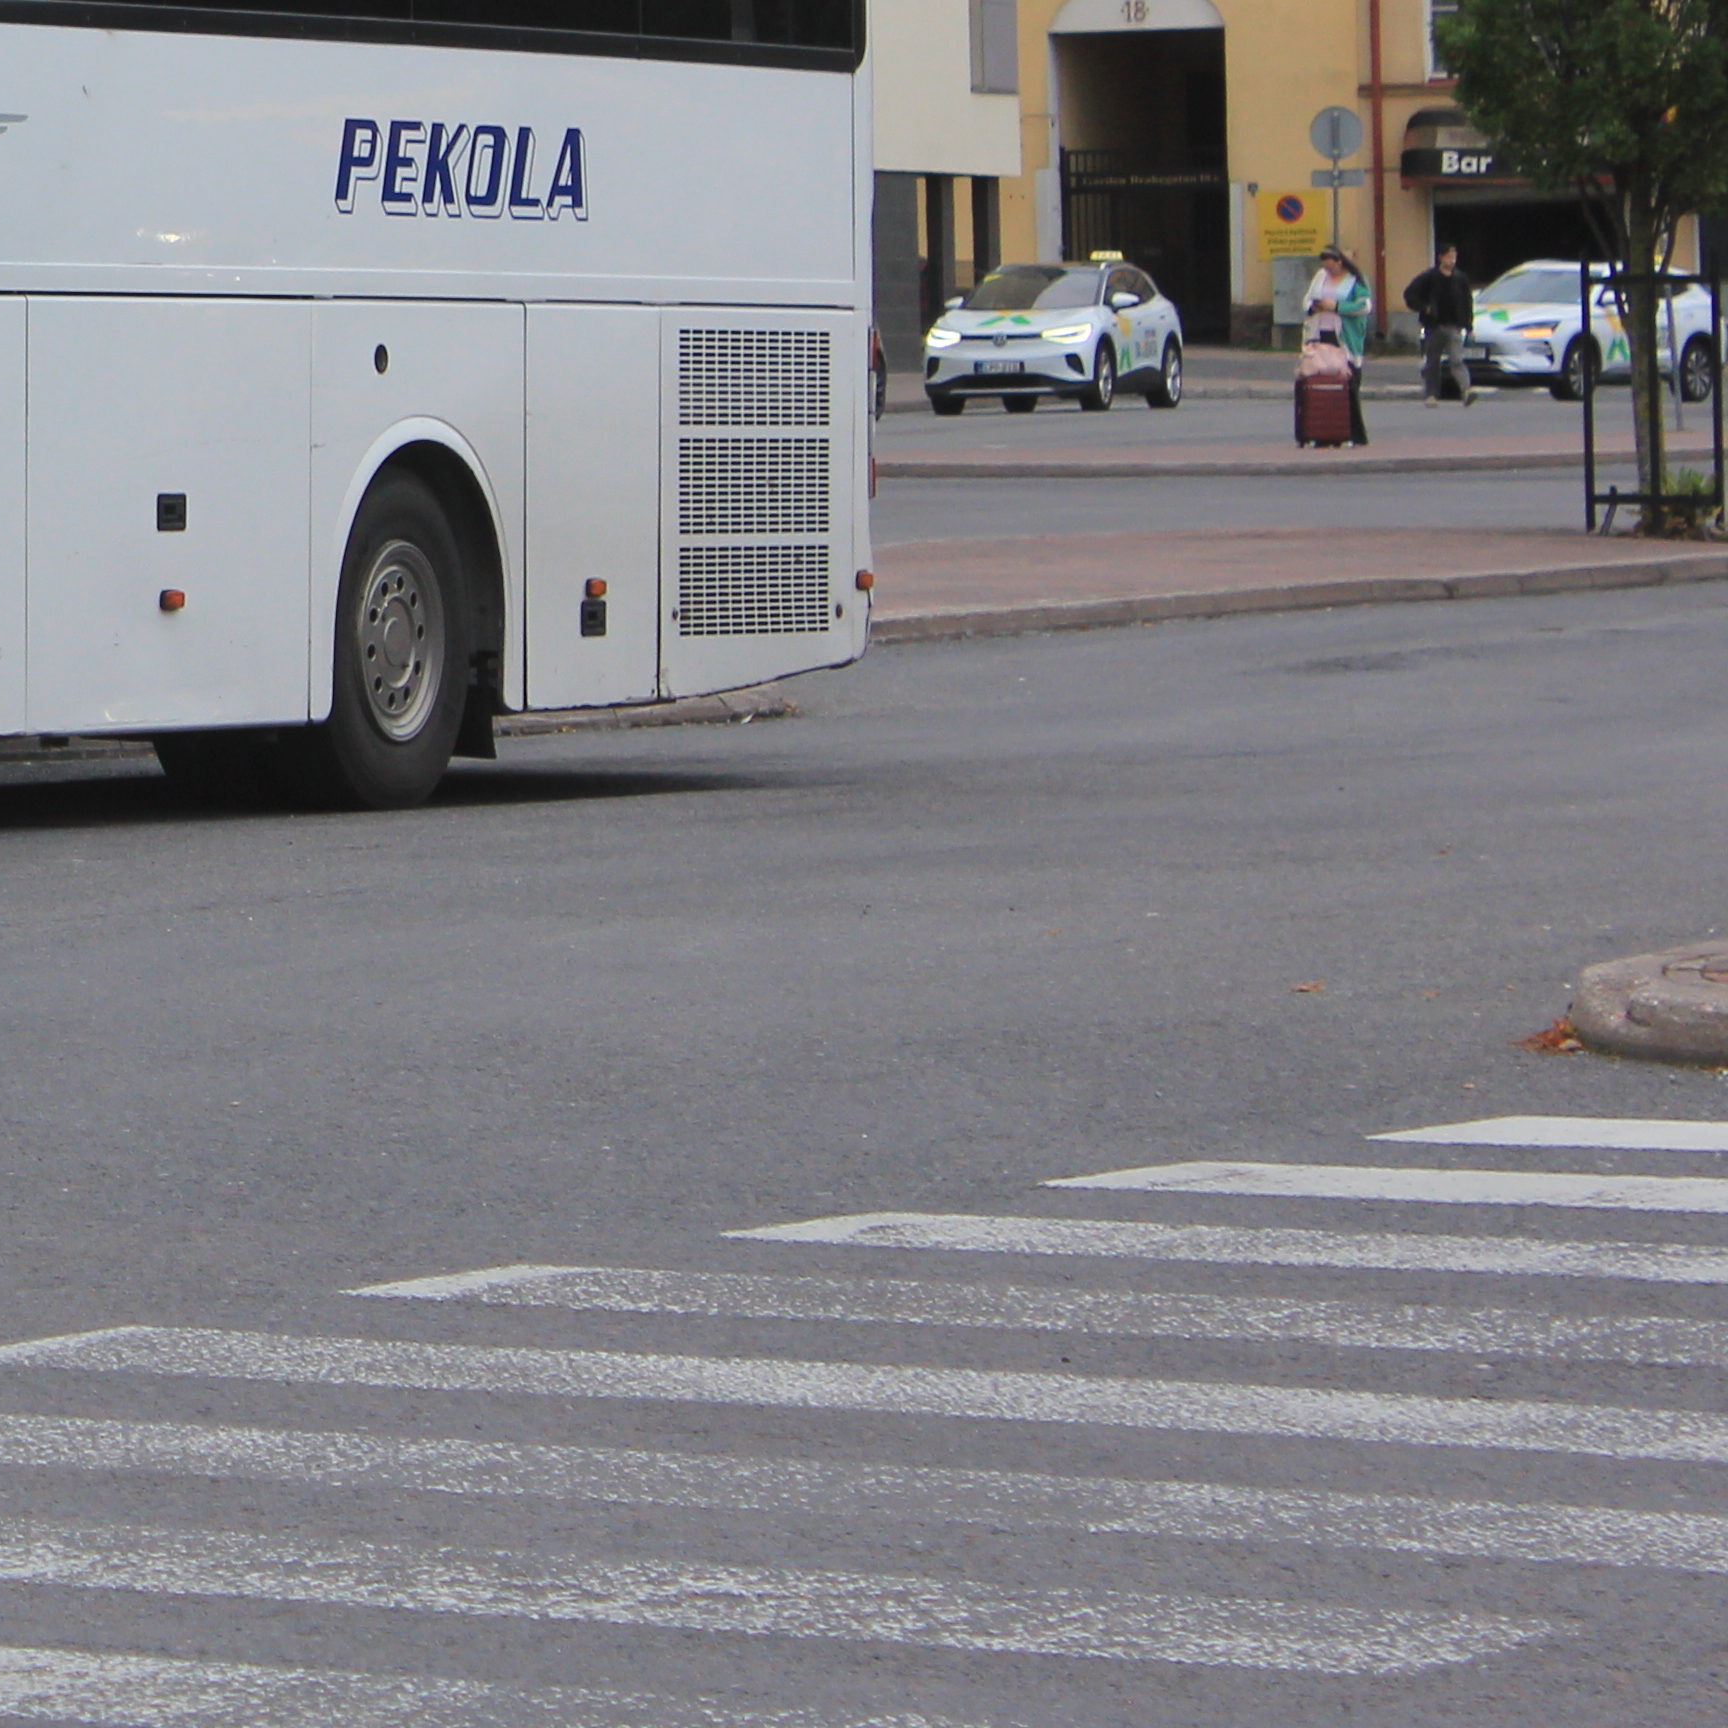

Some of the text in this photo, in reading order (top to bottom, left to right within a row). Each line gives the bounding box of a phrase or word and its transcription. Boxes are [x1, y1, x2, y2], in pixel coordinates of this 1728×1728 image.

[1123, 0, 1147, 22] 18
[334, 118, 589, 222] PEKOLA
[1441, 150, 1493, 173] Bar
